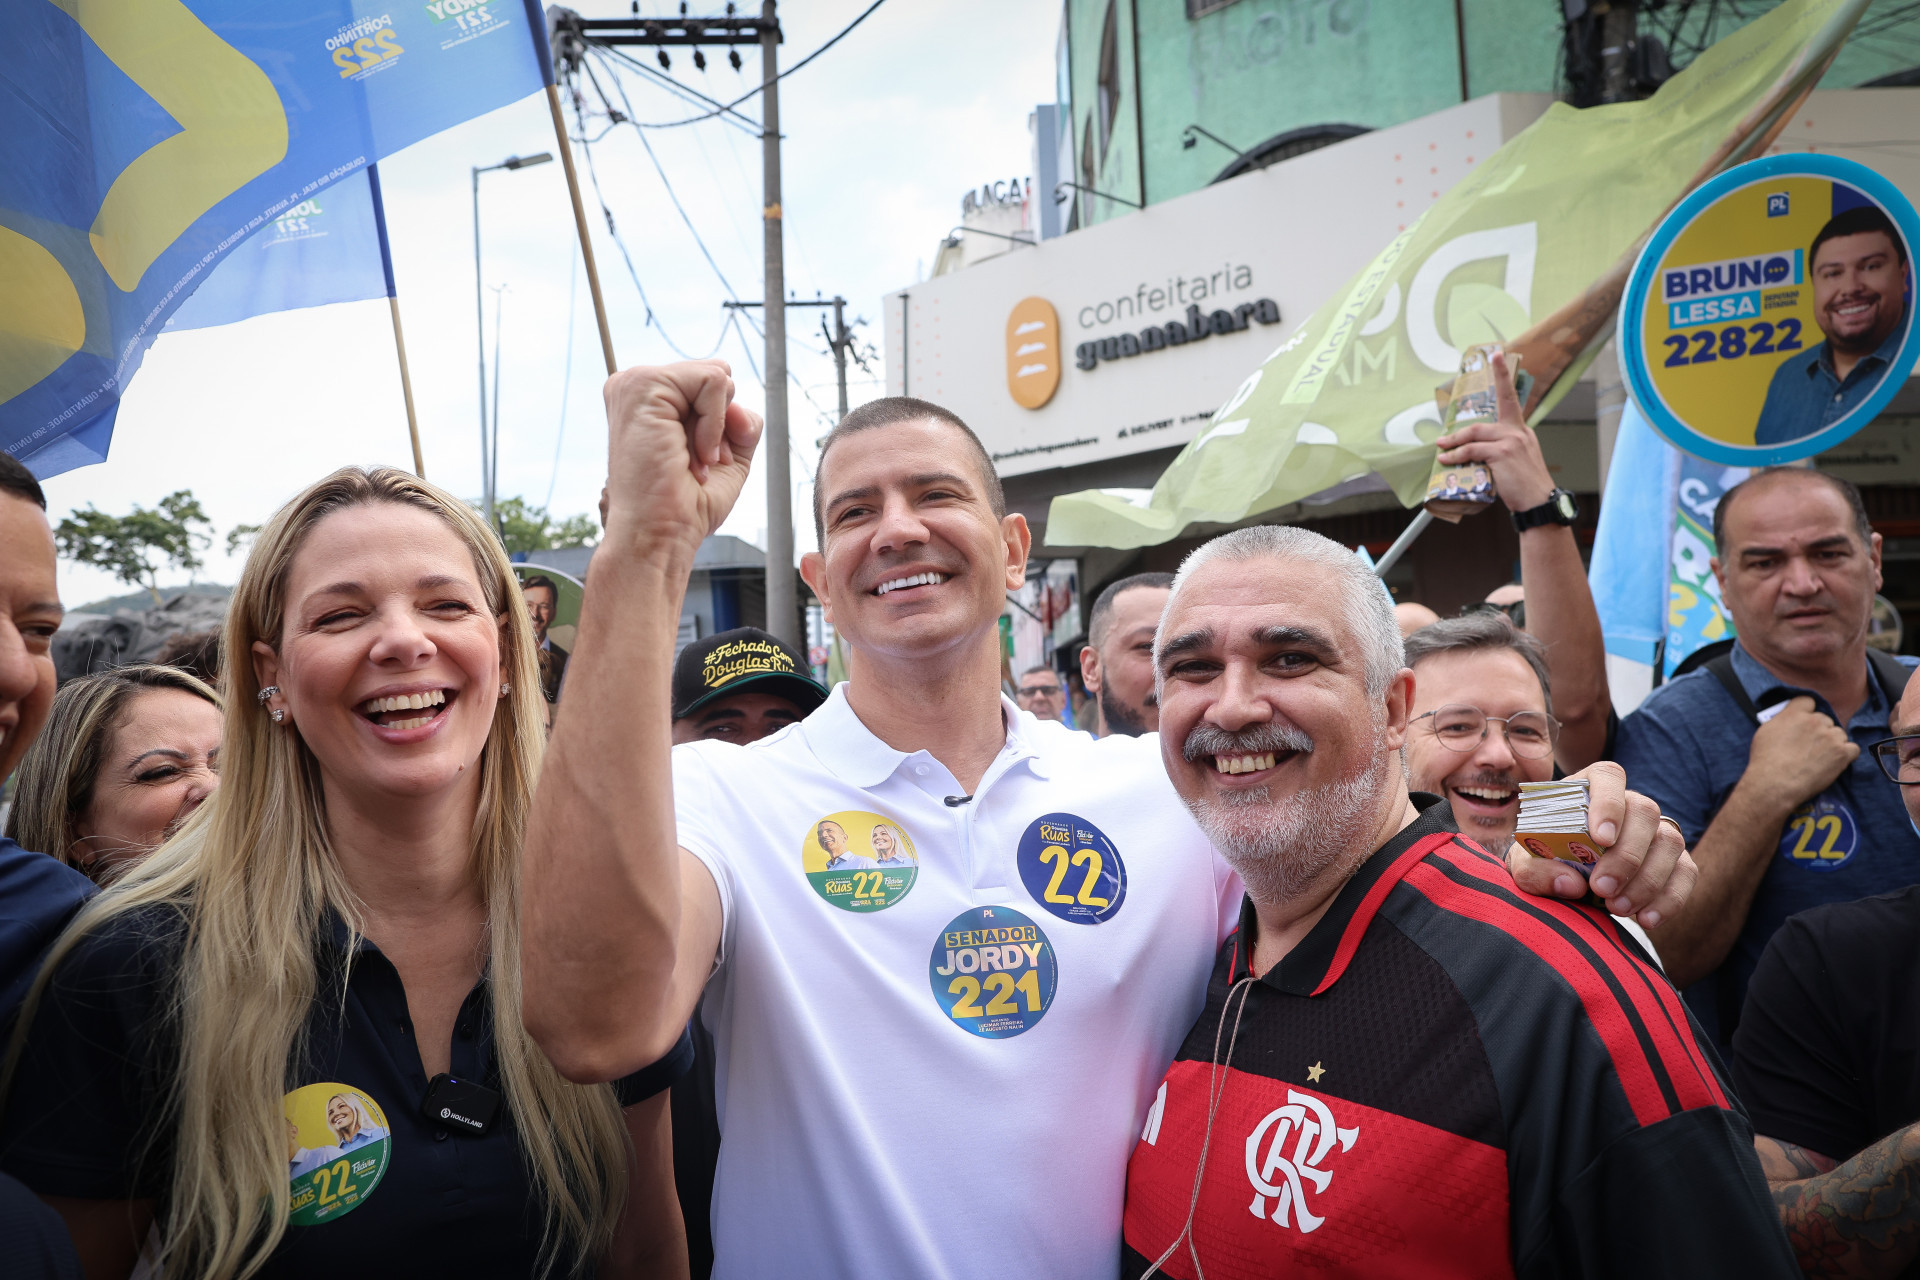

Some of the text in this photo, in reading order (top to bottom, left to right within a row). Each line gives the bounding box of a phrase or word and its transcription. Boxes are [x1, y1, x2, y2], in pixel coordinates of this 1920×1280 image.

[1769, 197, 1787, 211] PL
[1078, 263, 1253, 329] confeitaria
[1665, 256, 1790, 298] BRUNO
[1673, 296, 1756, 325] LESSA
[1076, 298, 1281, 371] guanabara
[1292, 268, 1387, 395] ESTADUAL
[1663, 317, 1803, 369] 22822
[1040, 824, 1070, 843] Ruas
[1790, 814, 1846, 859] 22
[825, 880, 853, 895] Ruas
[853, 871, 886, 899] 22
[1039, 845, 1109, 908] 22
[983, 909, 995, 918] PL
[947, 926, 1036, 947] SENADOR
[936, 941, 1043, 976] JORDY
[947, 969, 1042, 1019] 221
[450, 1112, 483, 1129] HOLLYLAND
[312, 1159, 357, 1206] 22
